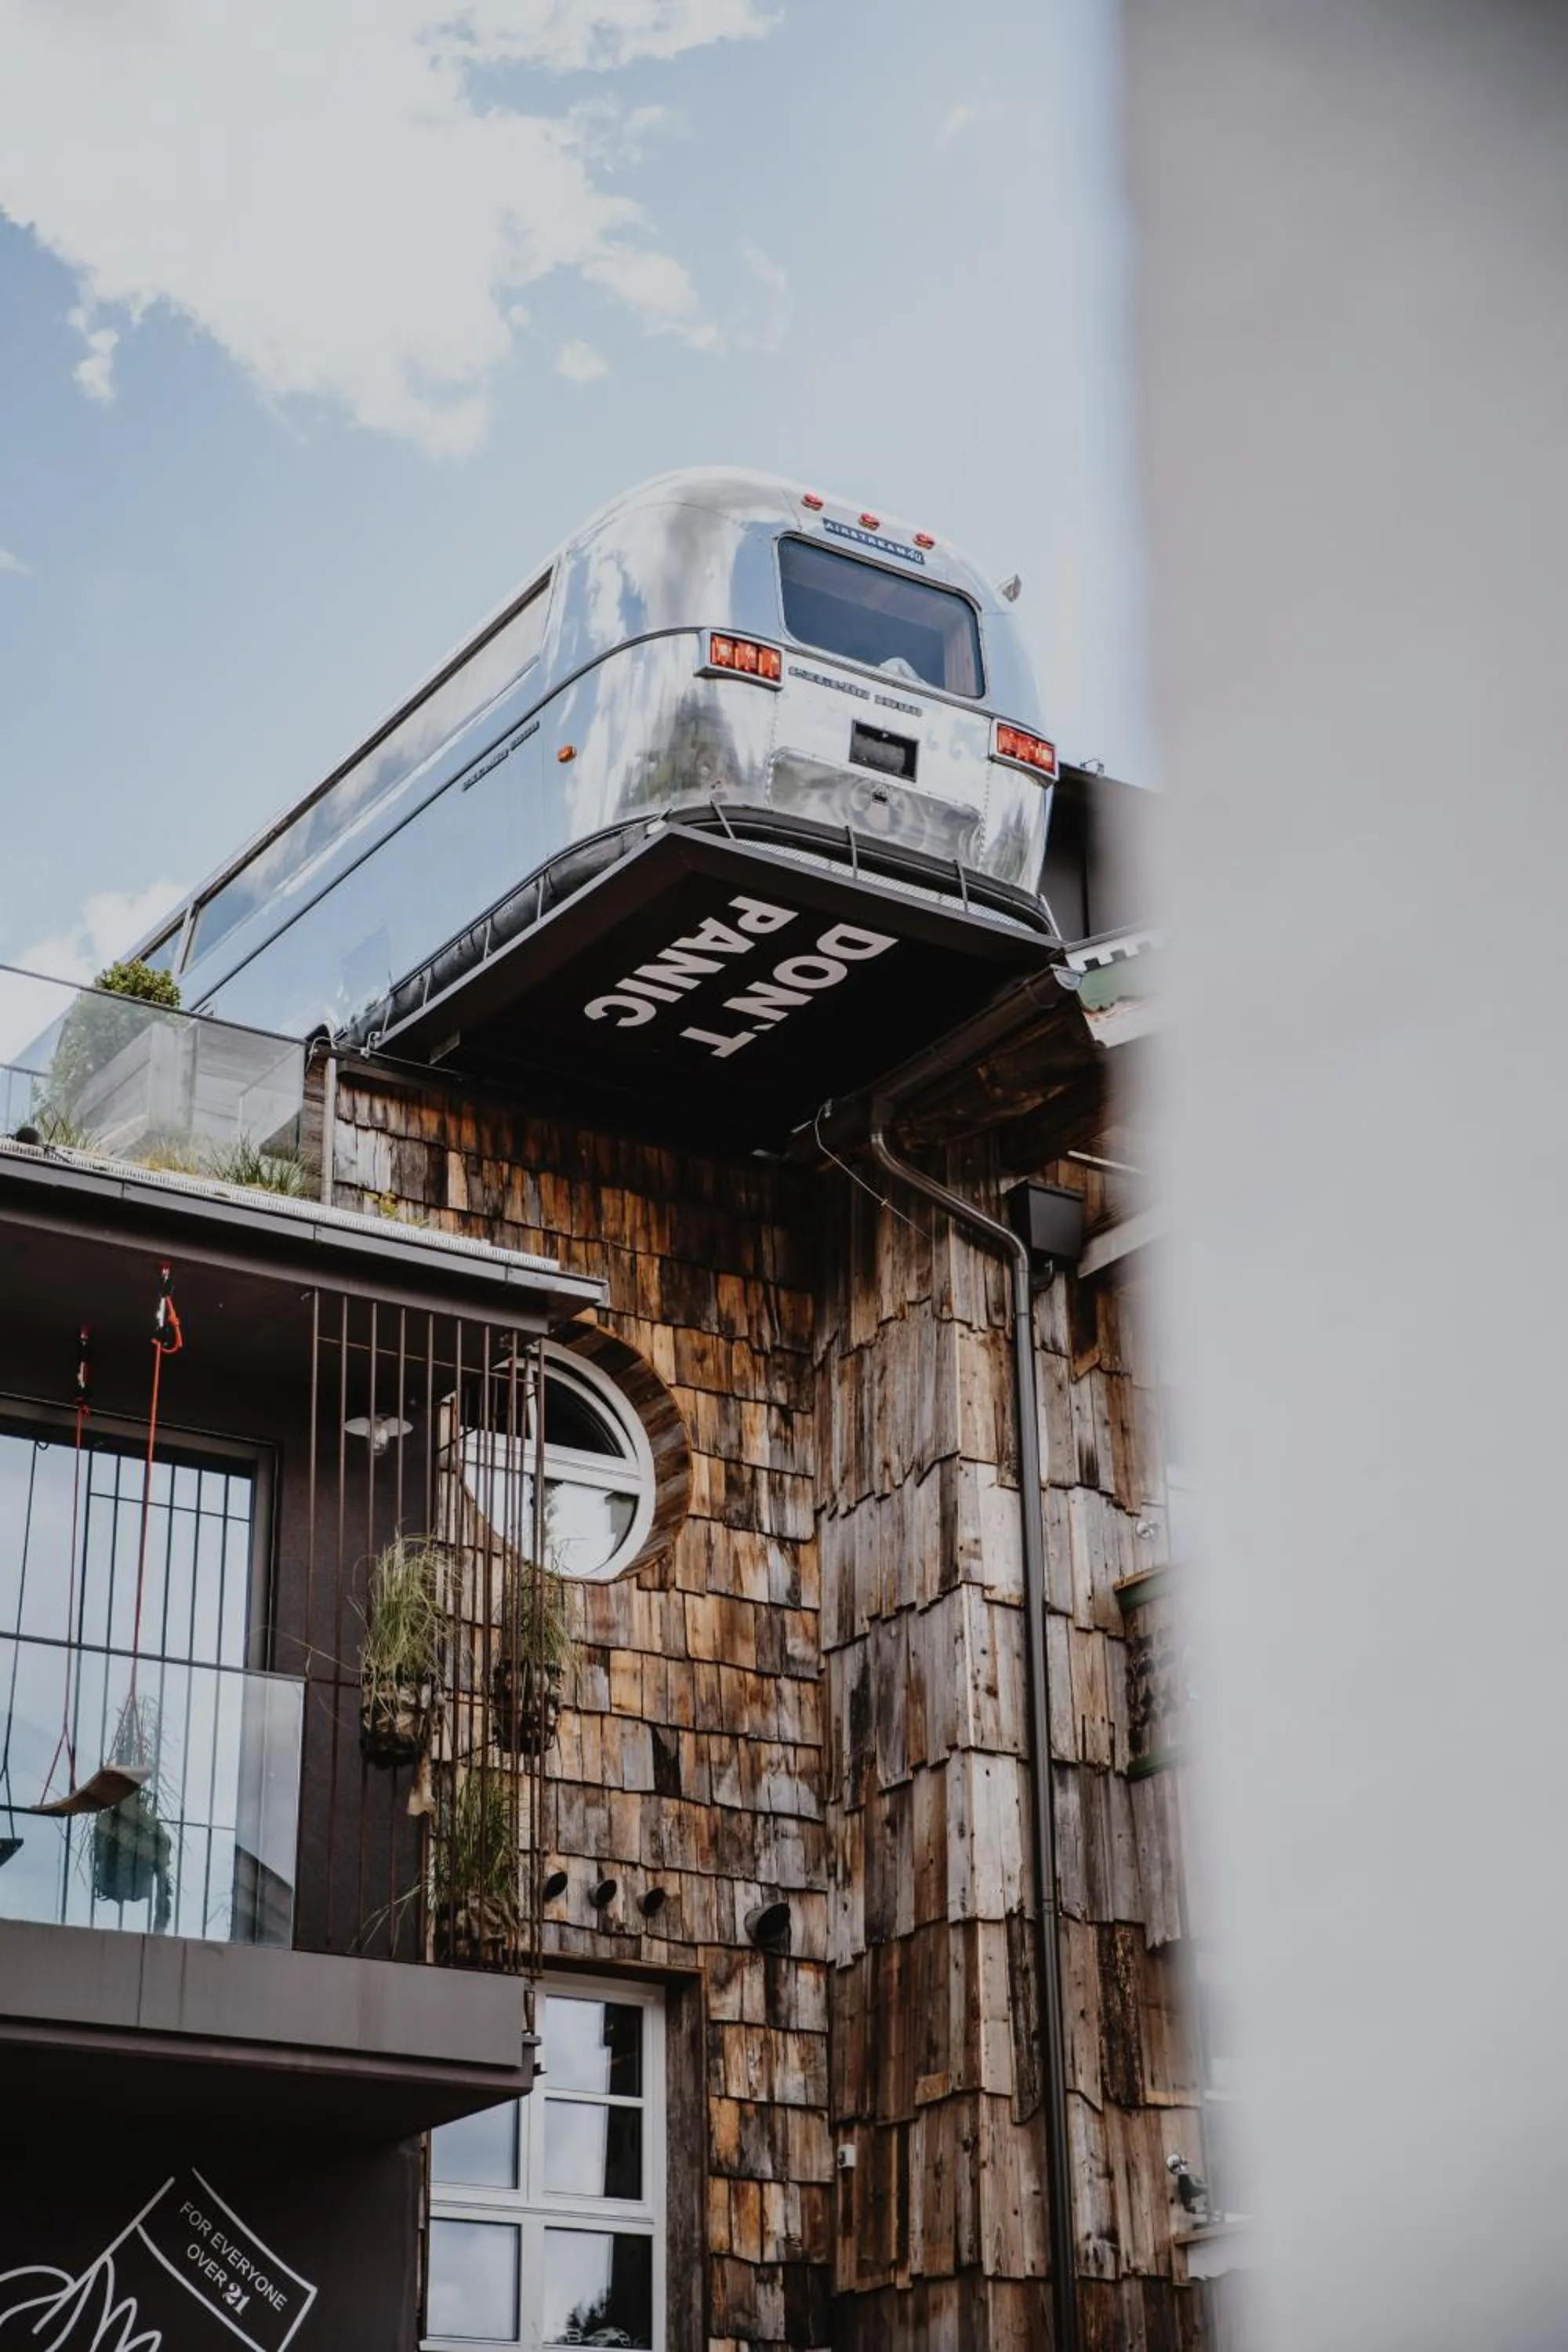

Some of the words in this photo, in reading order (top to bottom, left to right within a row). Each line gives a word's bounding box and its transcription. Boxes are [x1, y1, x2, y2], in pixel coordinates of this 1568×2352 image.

[585, 896, 799, 1026] PANIC
[681, 924, 898, 1058] DON'T
[179, 2201, 212, 2237] FOR
[209, 2232, 289, 2312] EVERYONE
[187, 2243, 229, 2288] OVER
[222, 2281, 251, 2317] 21
